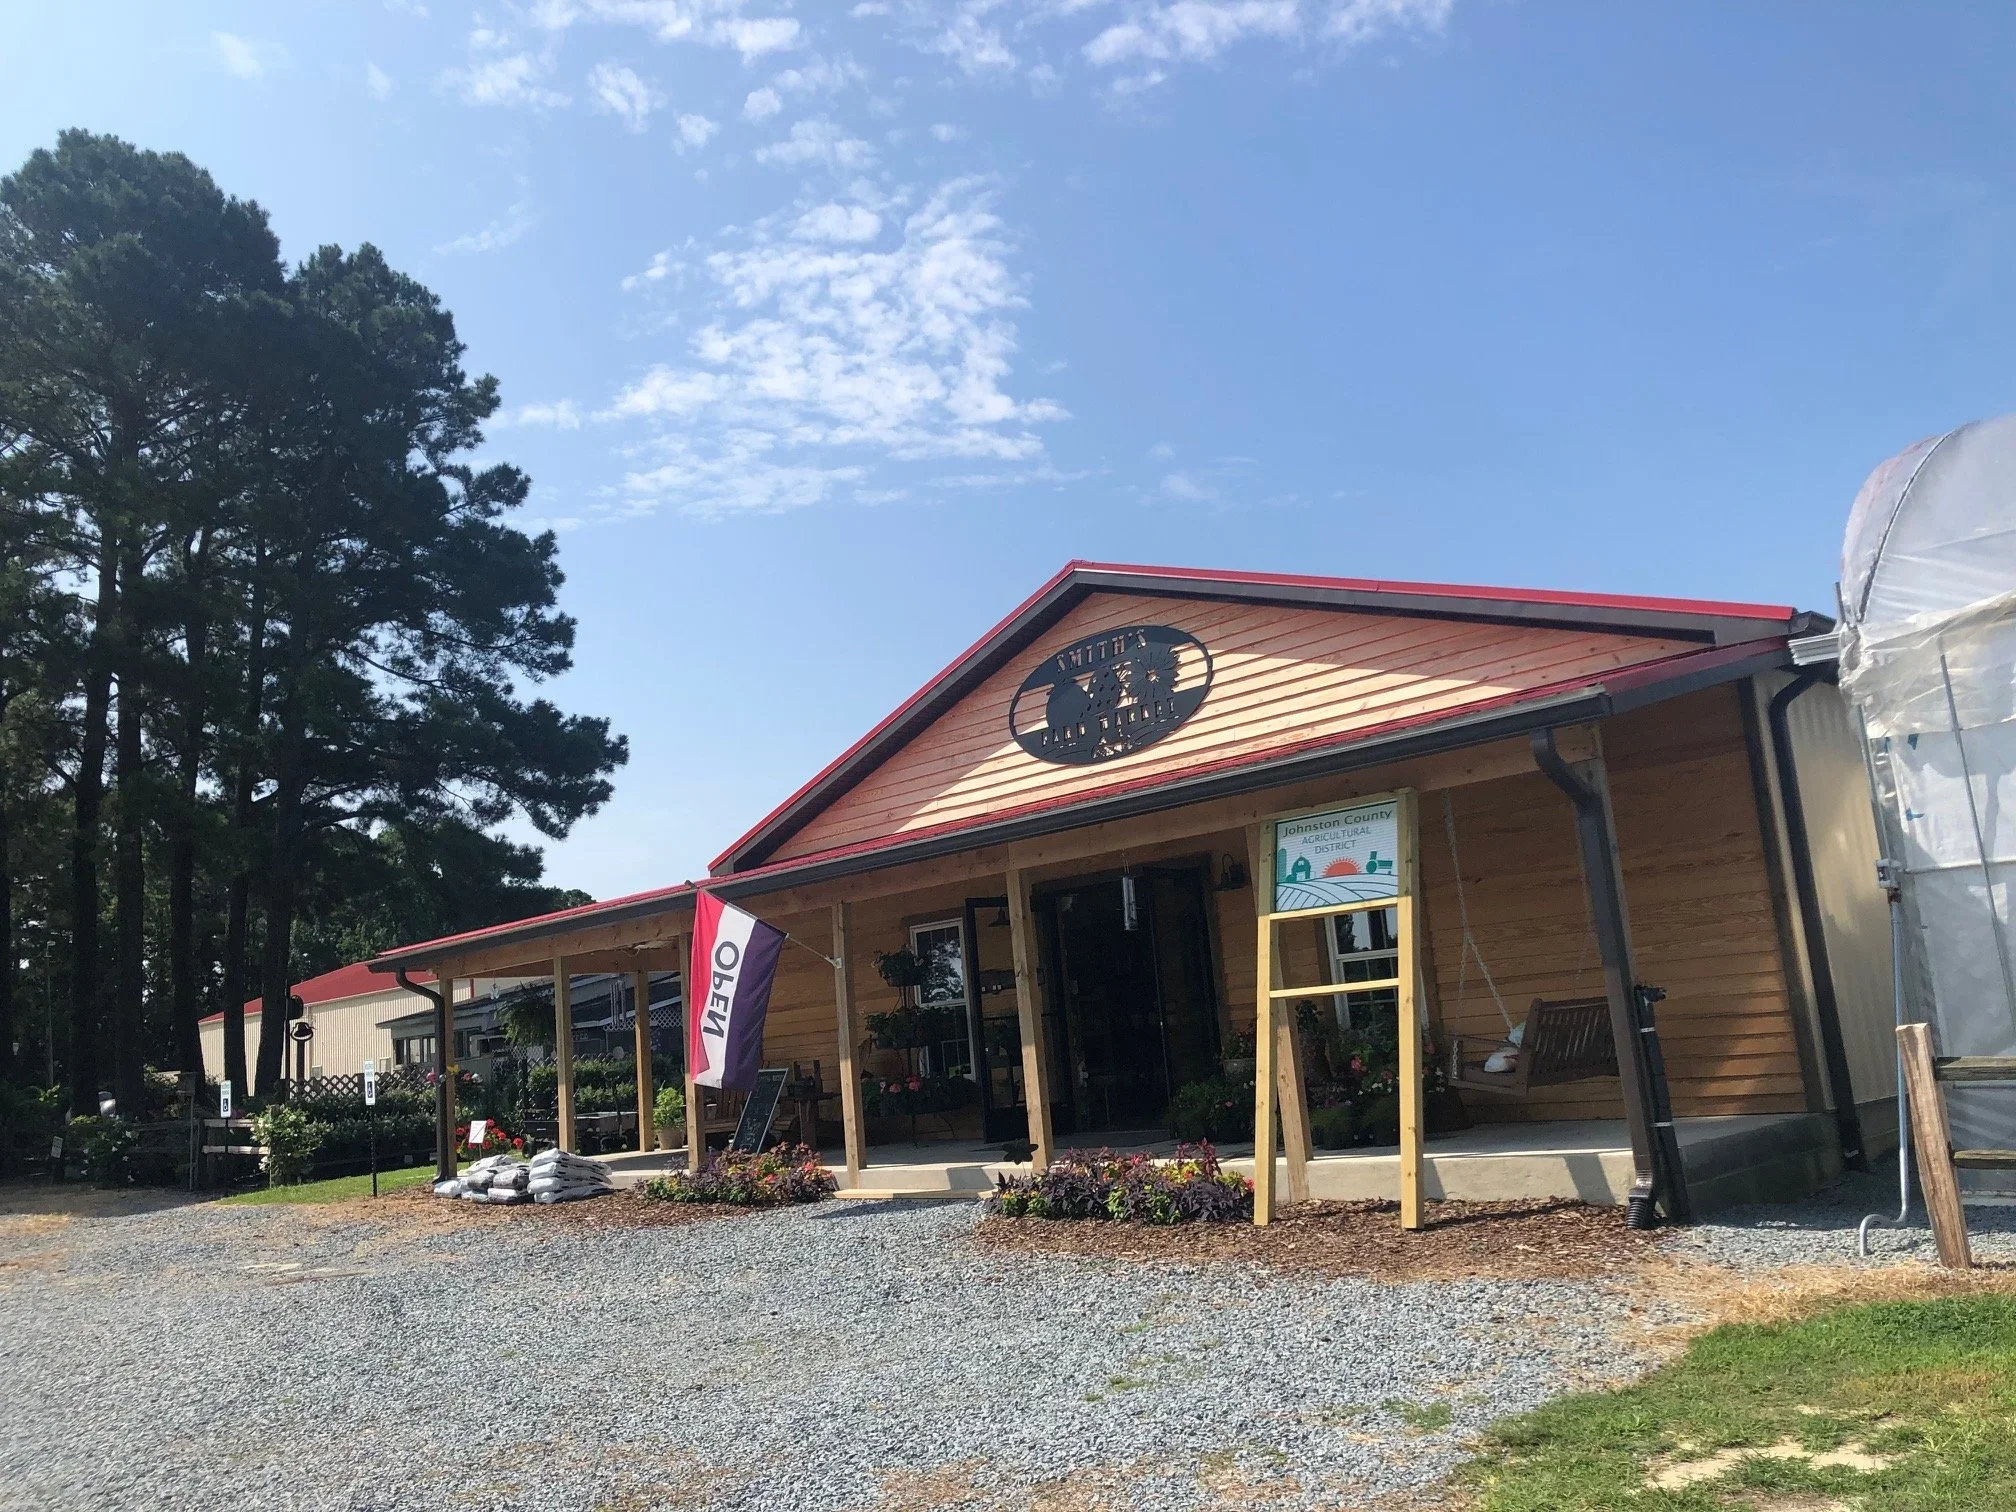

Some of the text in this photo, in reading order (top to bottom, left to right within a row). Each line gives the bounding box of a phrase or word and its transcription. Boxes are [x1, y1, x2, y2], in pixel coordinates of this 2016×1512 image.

[1057, 629, 1146, 672] SMITH'S
[1283, 810, 1392, 838] Johnston County
[1301, 826, 1371, 845] AGRICULTURAL
[1315, 840, 1357, 854] DISTRICT
